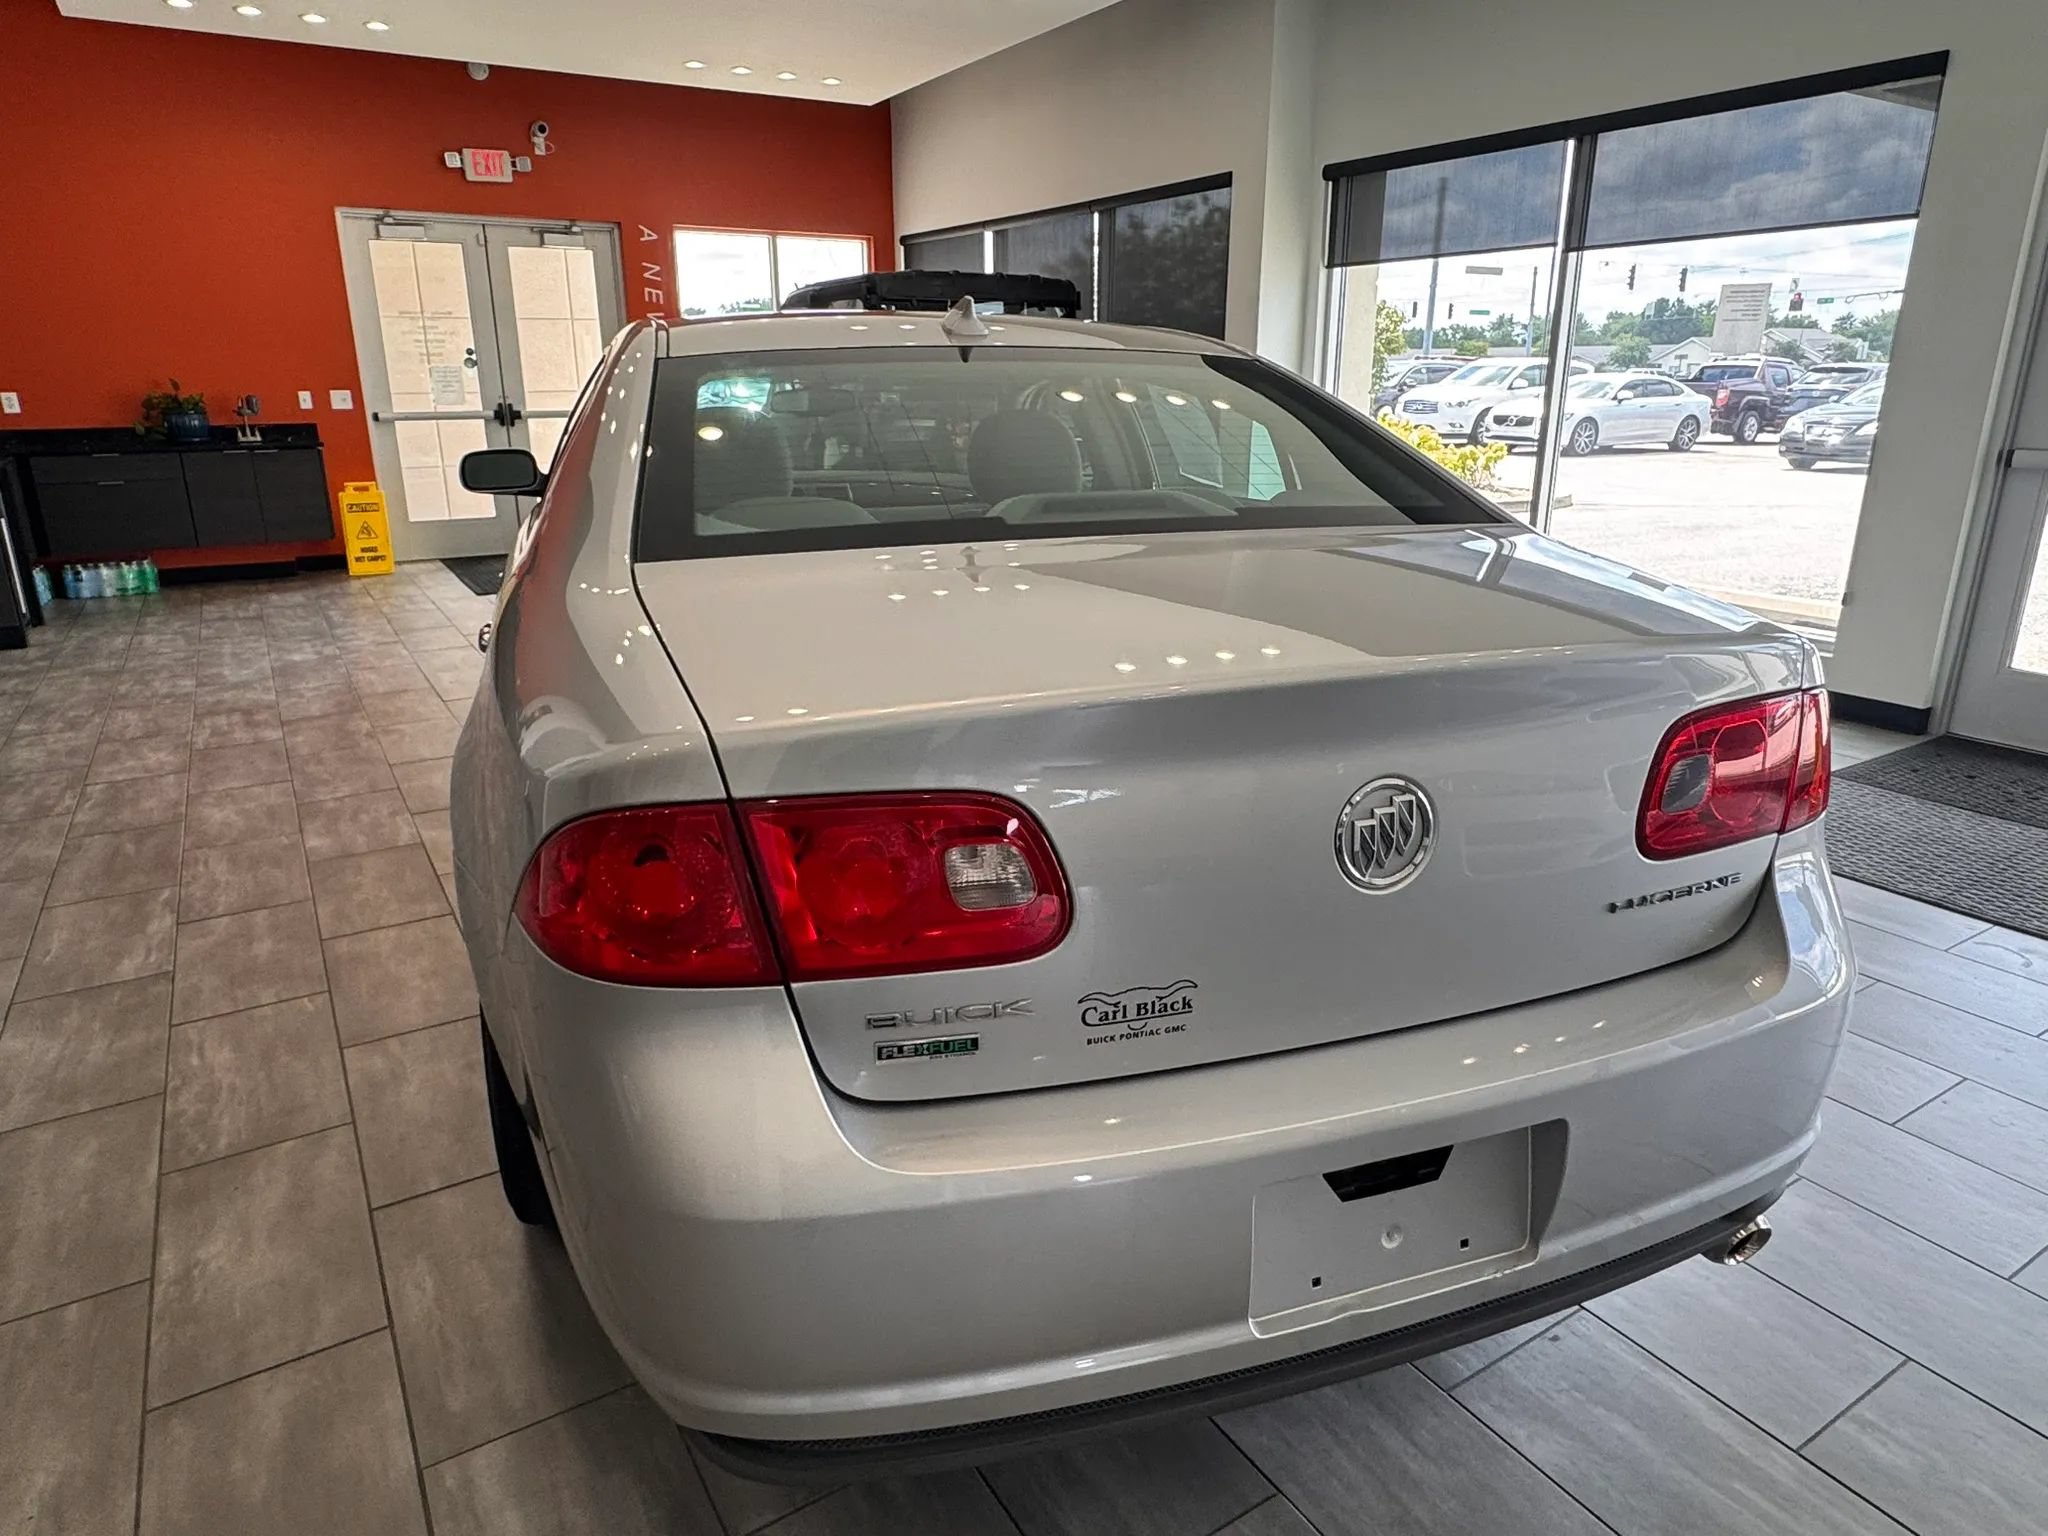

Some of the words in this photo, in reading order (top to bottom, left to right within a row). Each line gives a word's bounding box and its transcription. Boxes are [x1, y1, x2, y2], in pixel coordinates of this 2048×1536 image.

[471, 148, 505, 177] EXIT
[637, 224, 658, 242] A
[347, 503, 379, 512] CAUTION
[865, 997, 1035, 1029] BUICK
[1081, 1004, 1128, 1027] Carl
[1135, 996, 1194, 1017] Black
[1086, 1034, 1116, 1046] BUICK
[1119, 1028, 1161, 1041] PONTIAC
[1164, 1024, 1187, 1034] GMC
